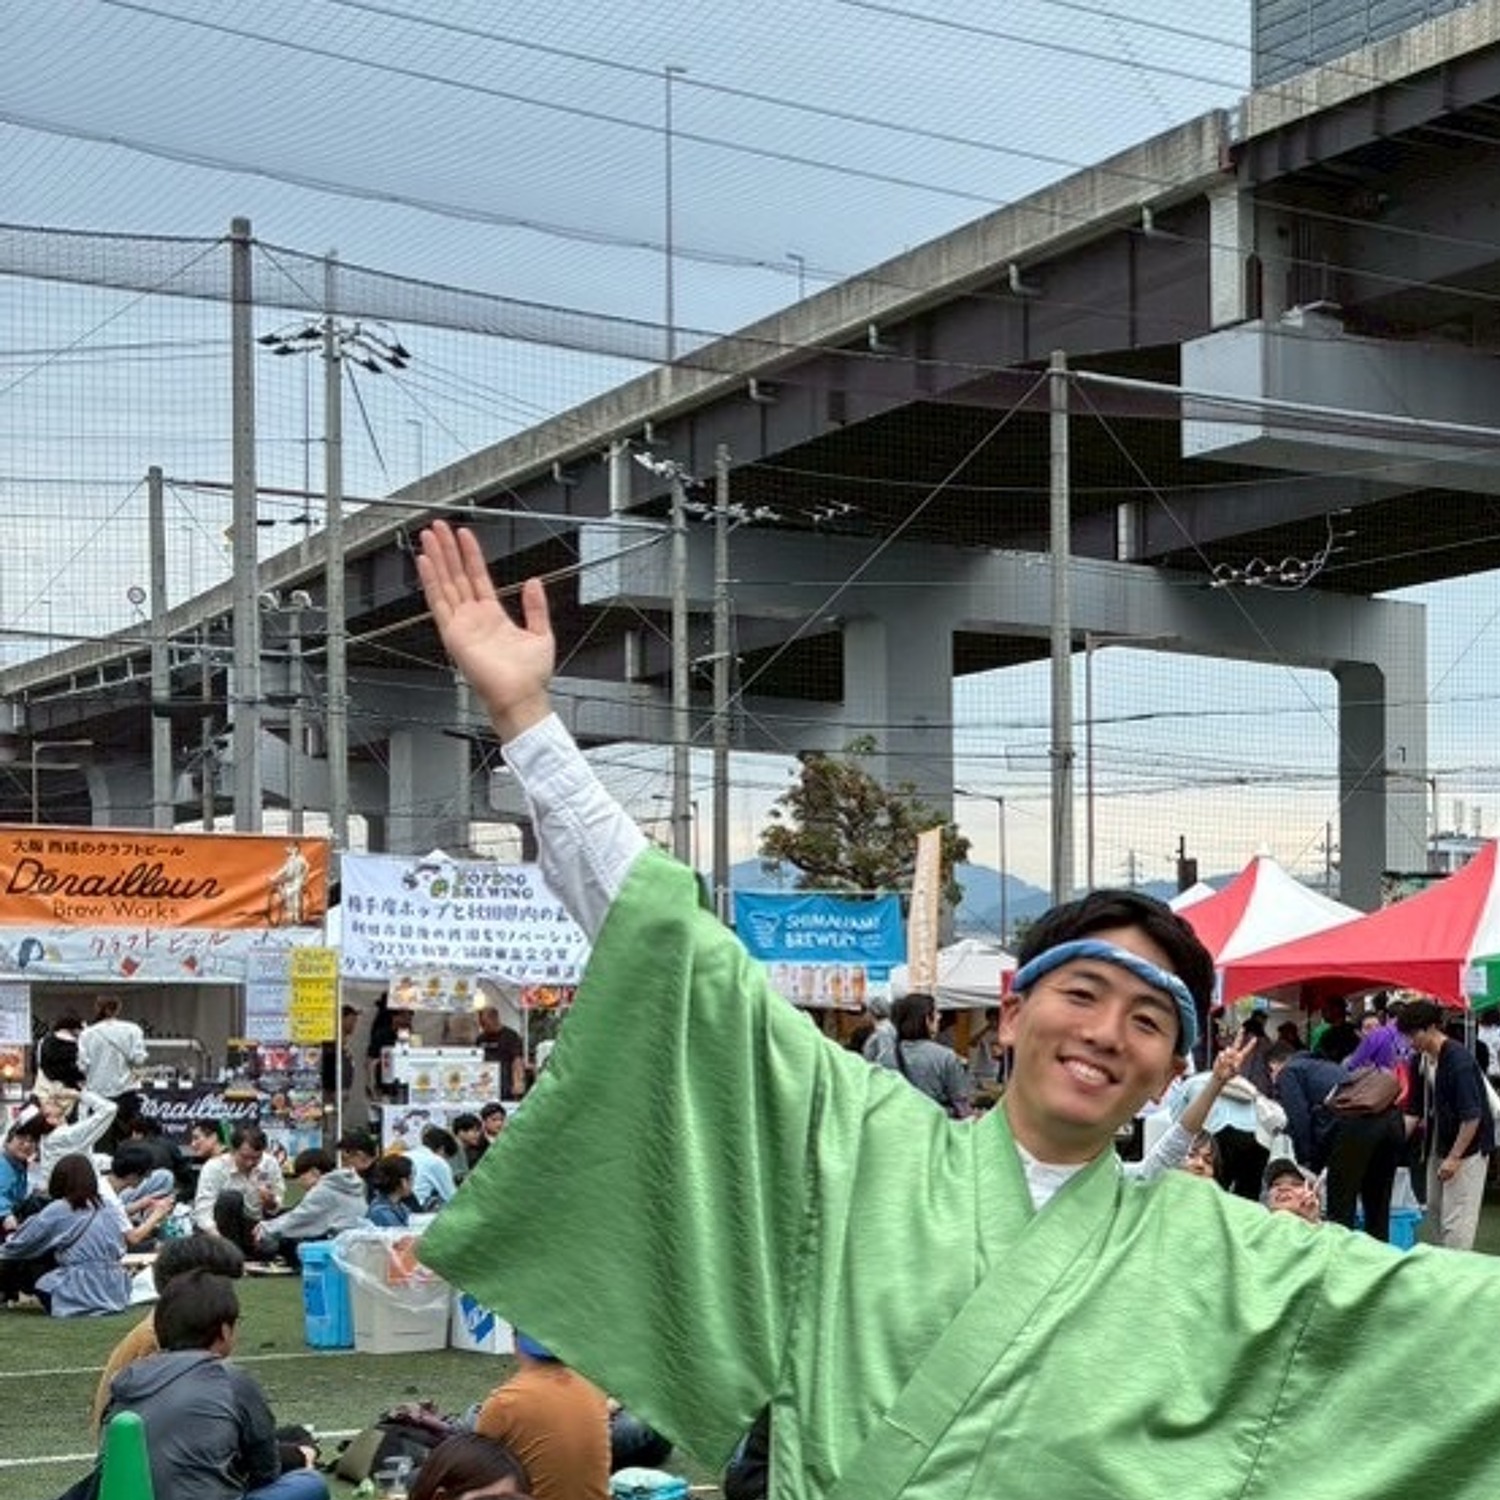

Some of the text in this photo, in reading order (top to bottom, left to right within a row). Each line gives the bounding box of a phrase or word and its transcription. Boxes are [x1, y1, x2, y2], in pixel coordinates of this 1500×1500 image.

[5, 857, 225, 899] Derailleur
[53, 901, 180, 919] Brew Works
